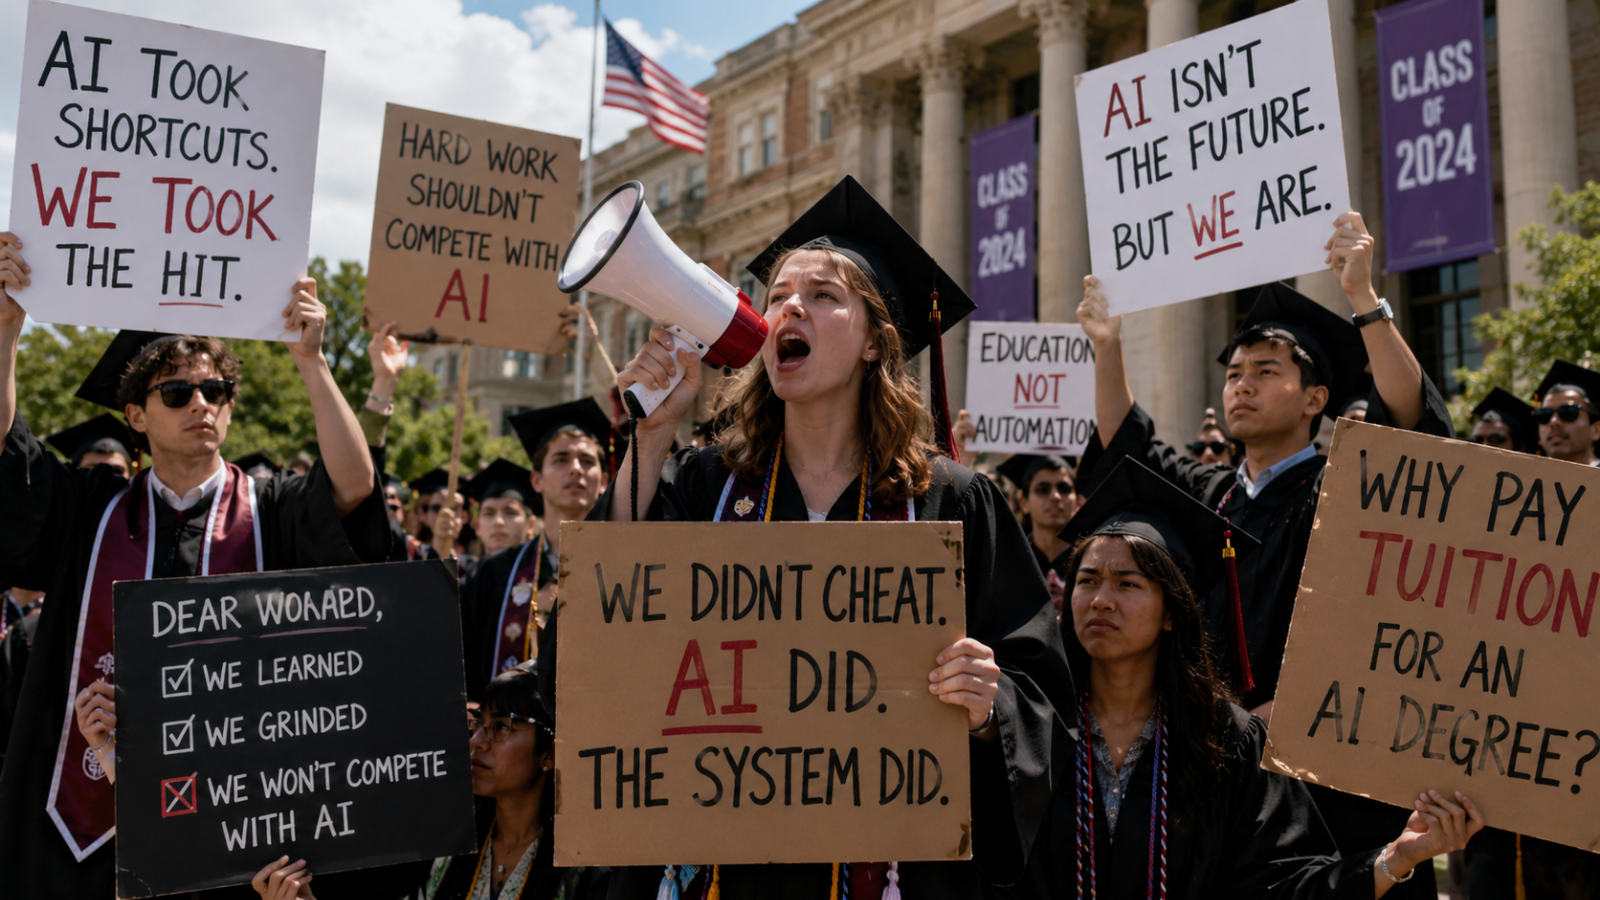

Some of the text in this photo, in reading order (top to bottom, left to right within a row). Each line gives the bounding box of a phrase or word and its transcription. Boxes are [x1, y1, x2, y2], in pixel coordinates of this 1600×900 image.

[38, 30, 249, 111] AI TOOK
[1104, 39, 1262, 138] AI ISN'T
[1390, 39, 1474, 102] CLASS
[54, 103, 278, 173] SHORTCUTS.
[1105, 86, 1325, 194] THE FUTURE.
[1422, 95, 1445, 128] OF
[399, 121, 558, 184] HARD WORK
[1395, 122, 1477, 192] 2024
[31, 163, 275, 242] WE TOOK
[407, 173, 544, 224] SHOULDN'T
[977, 161, 1029, 209] CLASS
[385, 218, 560, 272] COMPETE WITH
[994, 204, 1010, 231] OF
[1112, 165, 1332, 271] BUT WE ARE.
[56, 243, 242, 301] THE HIT.
[977, 227, 1027, 279] 2024
[434, 268, 490, 323] AI
[980, 332, 1095, 364] EDUCATION
[1013, 373, 1067, 404] NOT
[1359, 449, 1587, 546] WHY PAY
[594, 562, 667, 624] WE
[822, 564, 947, 626] CHEAT.
[1359, 530, 1600, 638] TUITION
[152, 595, 242, 638] DEAR
[203, 650, 363, 692] WE LEARNED
[665, 638, 888, 717] AI DID.
[1369, 621, 1525, 698] FOR AN
[205, 703, 368, 748] WE GRINDED
[1307, 680, 1600, 795] AI DEGREE?
[207, 750, 448, 807] WE WON'T COMPETE
[578, 745, 949, 810] THE SYSTEM DID.
[221, 801, 355, 852] WITH AI
